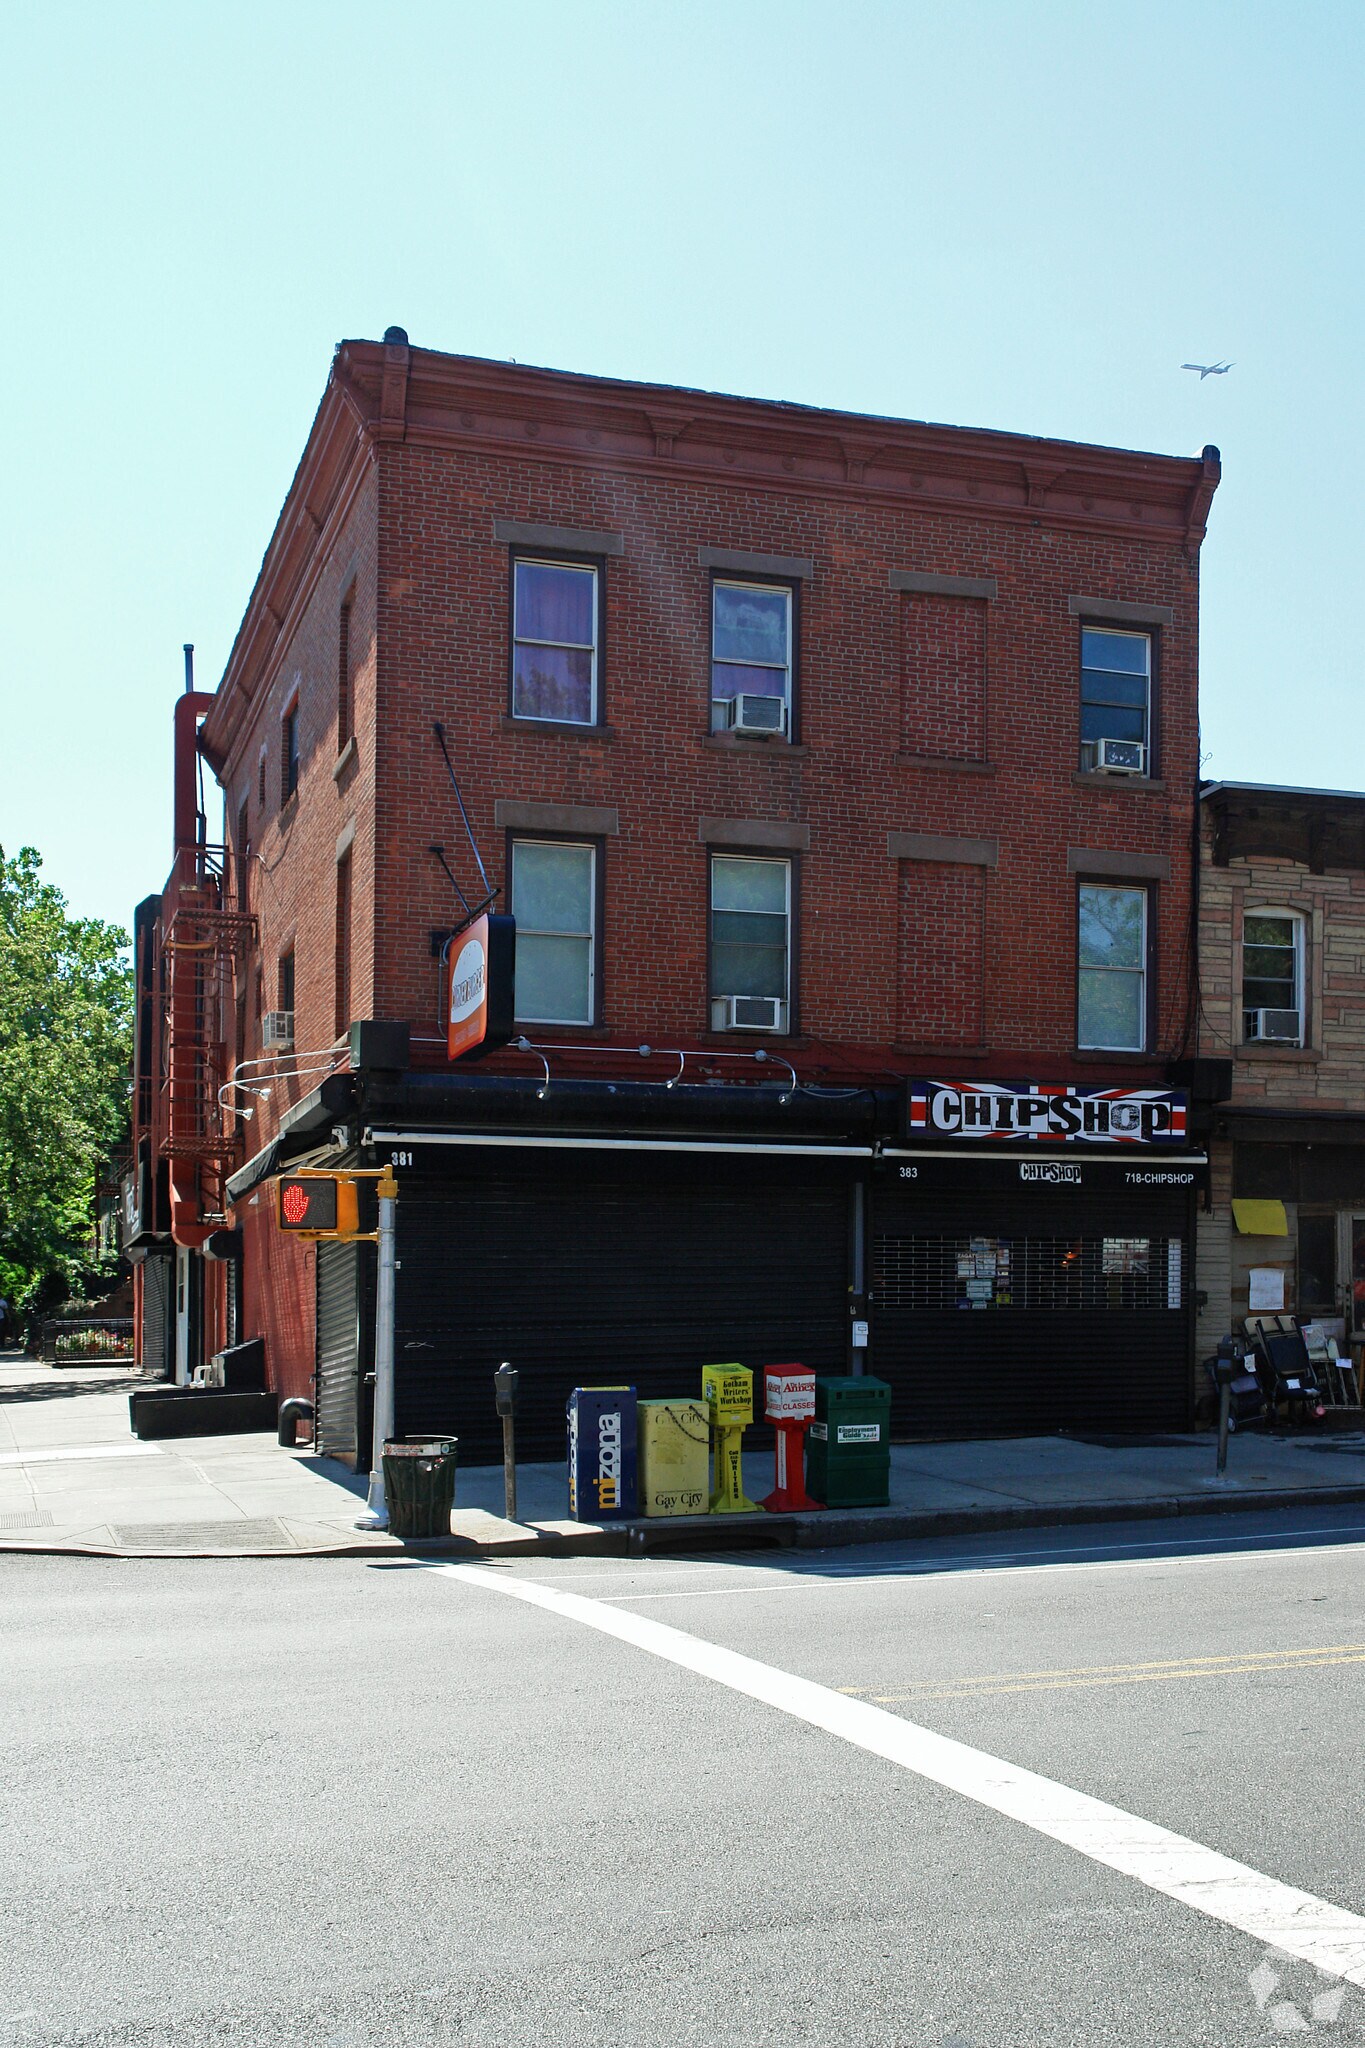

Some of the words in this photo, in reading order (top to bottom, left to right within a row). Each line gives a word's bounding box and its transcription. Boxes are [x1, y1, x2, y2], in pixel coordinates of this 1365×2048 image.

[391, 1151, 413, 1166] 381
[899, 1167, 918, 1179] 383
[1125, 1172, 1195, 1184] 718-CHIPSHOP
[723, 1380, 748, 1388] Gotham
[783, 1382, 815, 1393] Annex
[720, 1396, 752, 1405] Workshop
[783, 1402, 816, 1411] CLASSES
[838, 1425, 877, 1433] Employment
[593, 1413, 617, 1509] mizona
[730, 1459, 739, 1499] WRITERS
[655, 1494, 677, 1508] Gay
[680, 1493, 703, 1506] City
